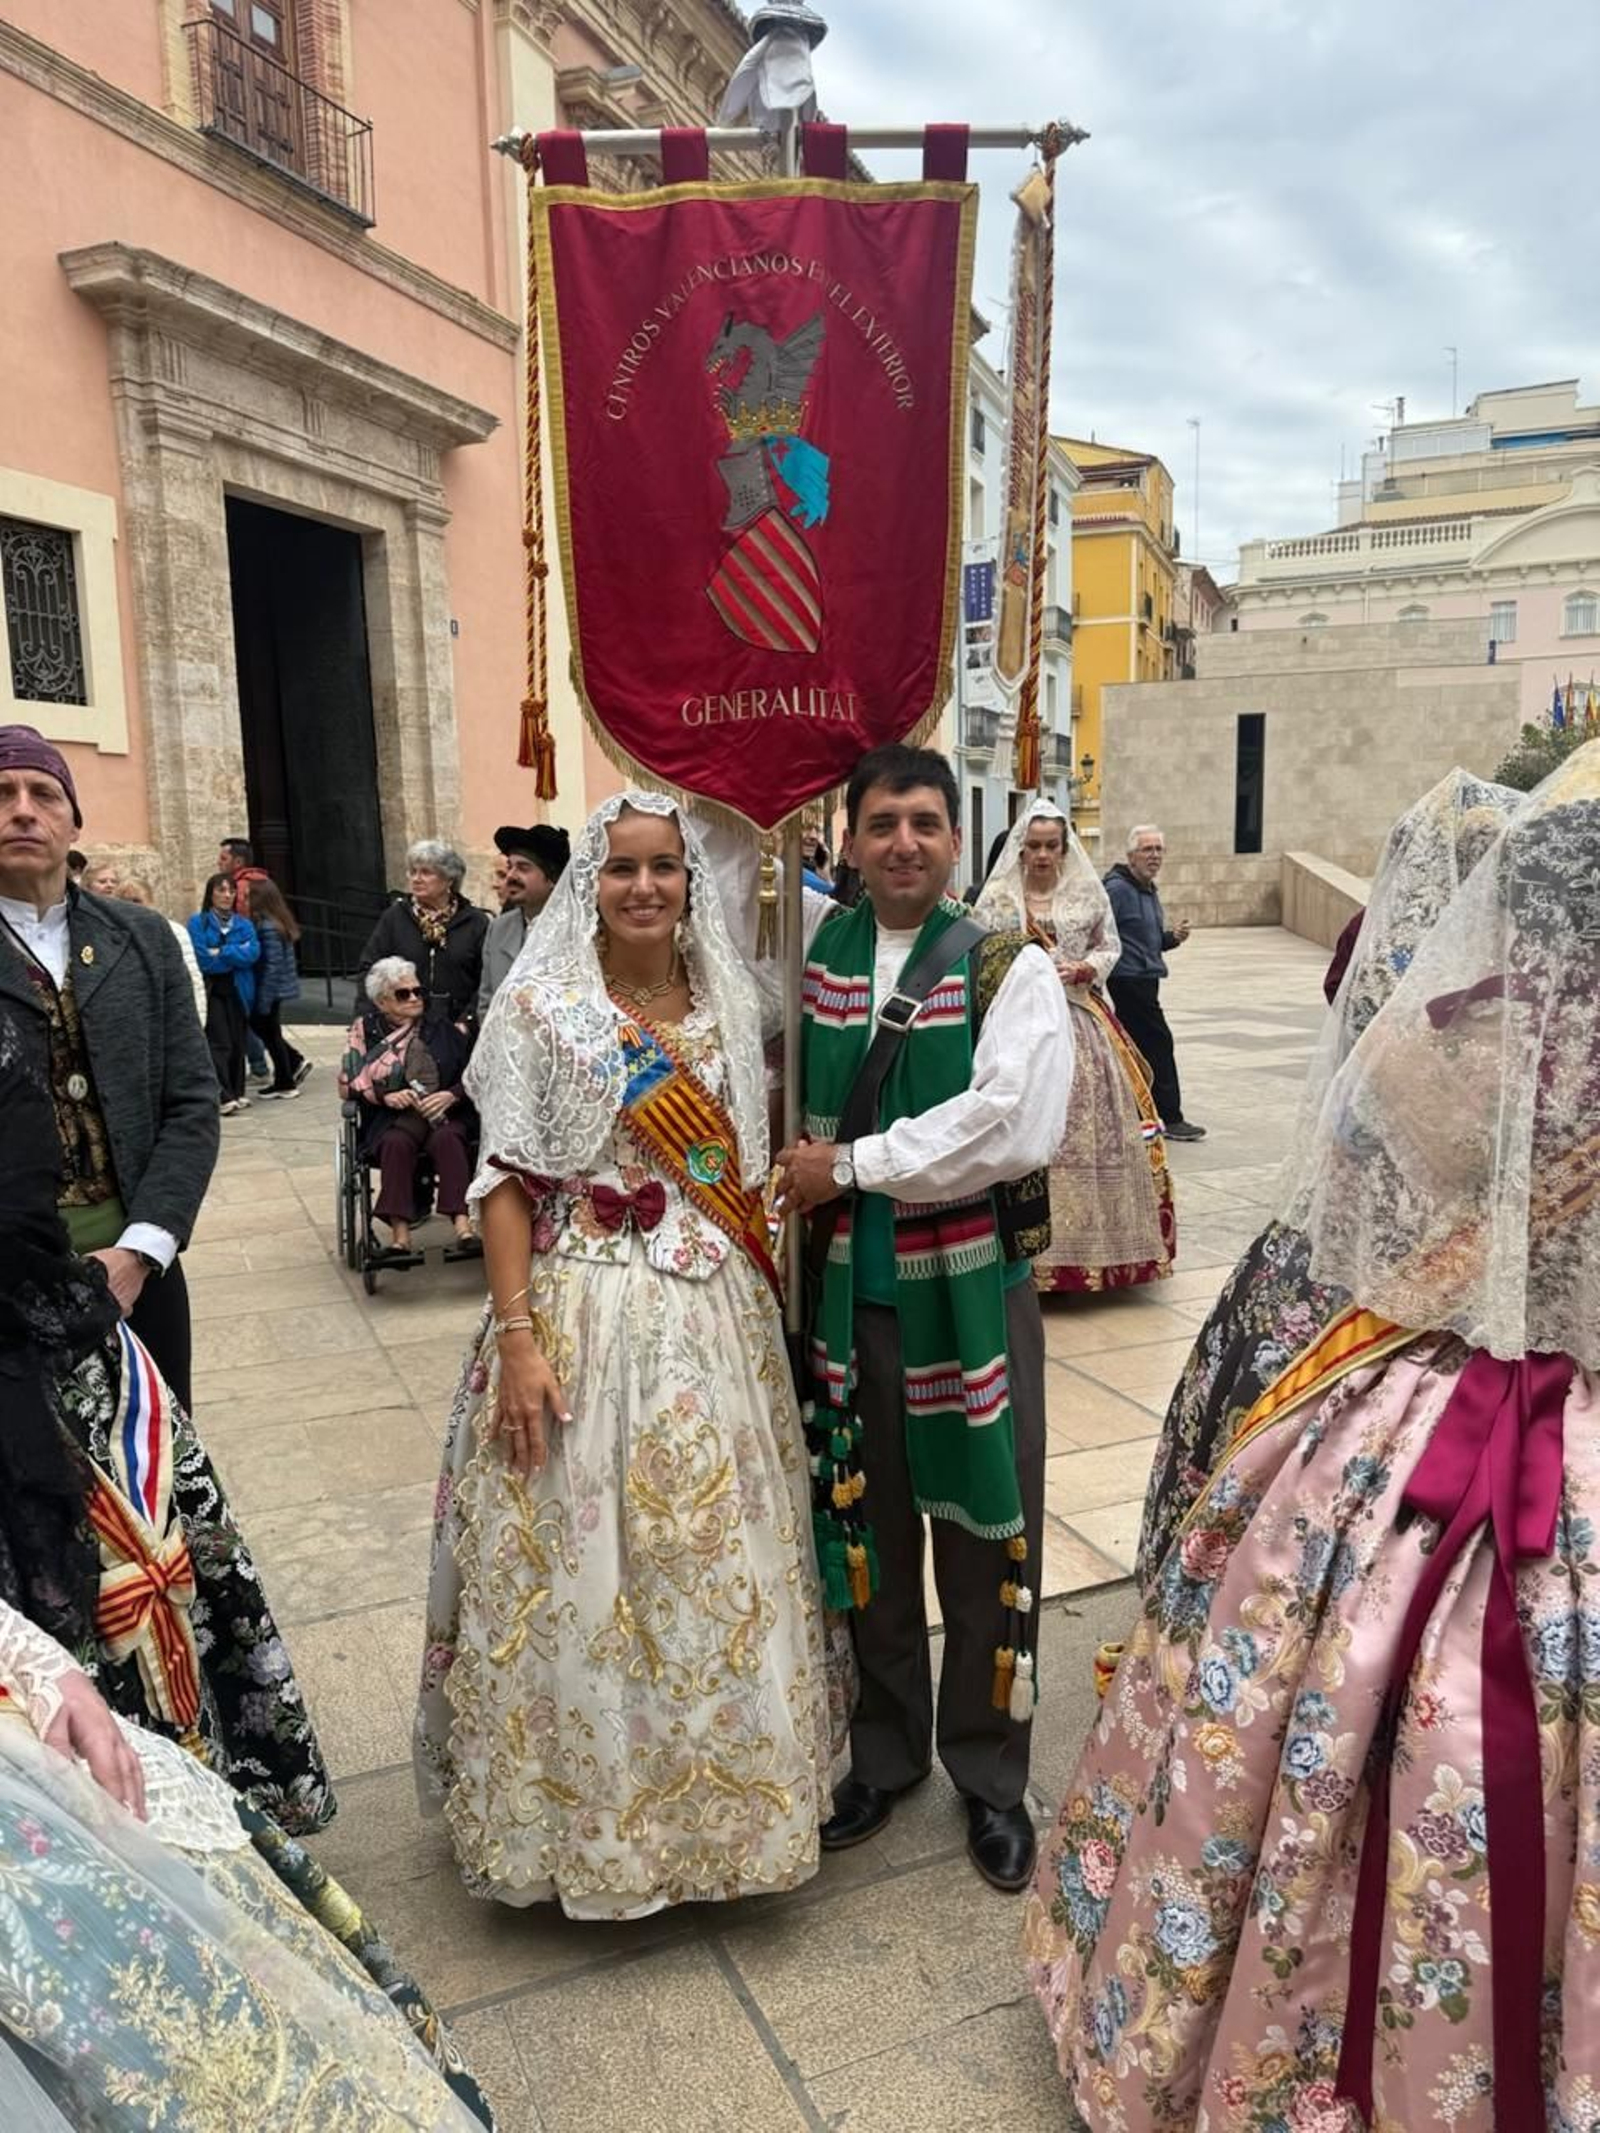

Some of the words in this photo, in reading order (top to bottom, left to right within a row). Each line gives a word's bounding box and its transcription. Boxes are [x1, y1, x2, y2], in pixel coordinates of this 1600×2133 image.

[606, 319, 660, 420] CENTROS
[654, 252, 803, 320] VALENCIANOS
[828, 283, 853, 314] EL
[852, 306, 914, 409] EXTERIOR
[681, 685, 857, 727] GENERALITAT
